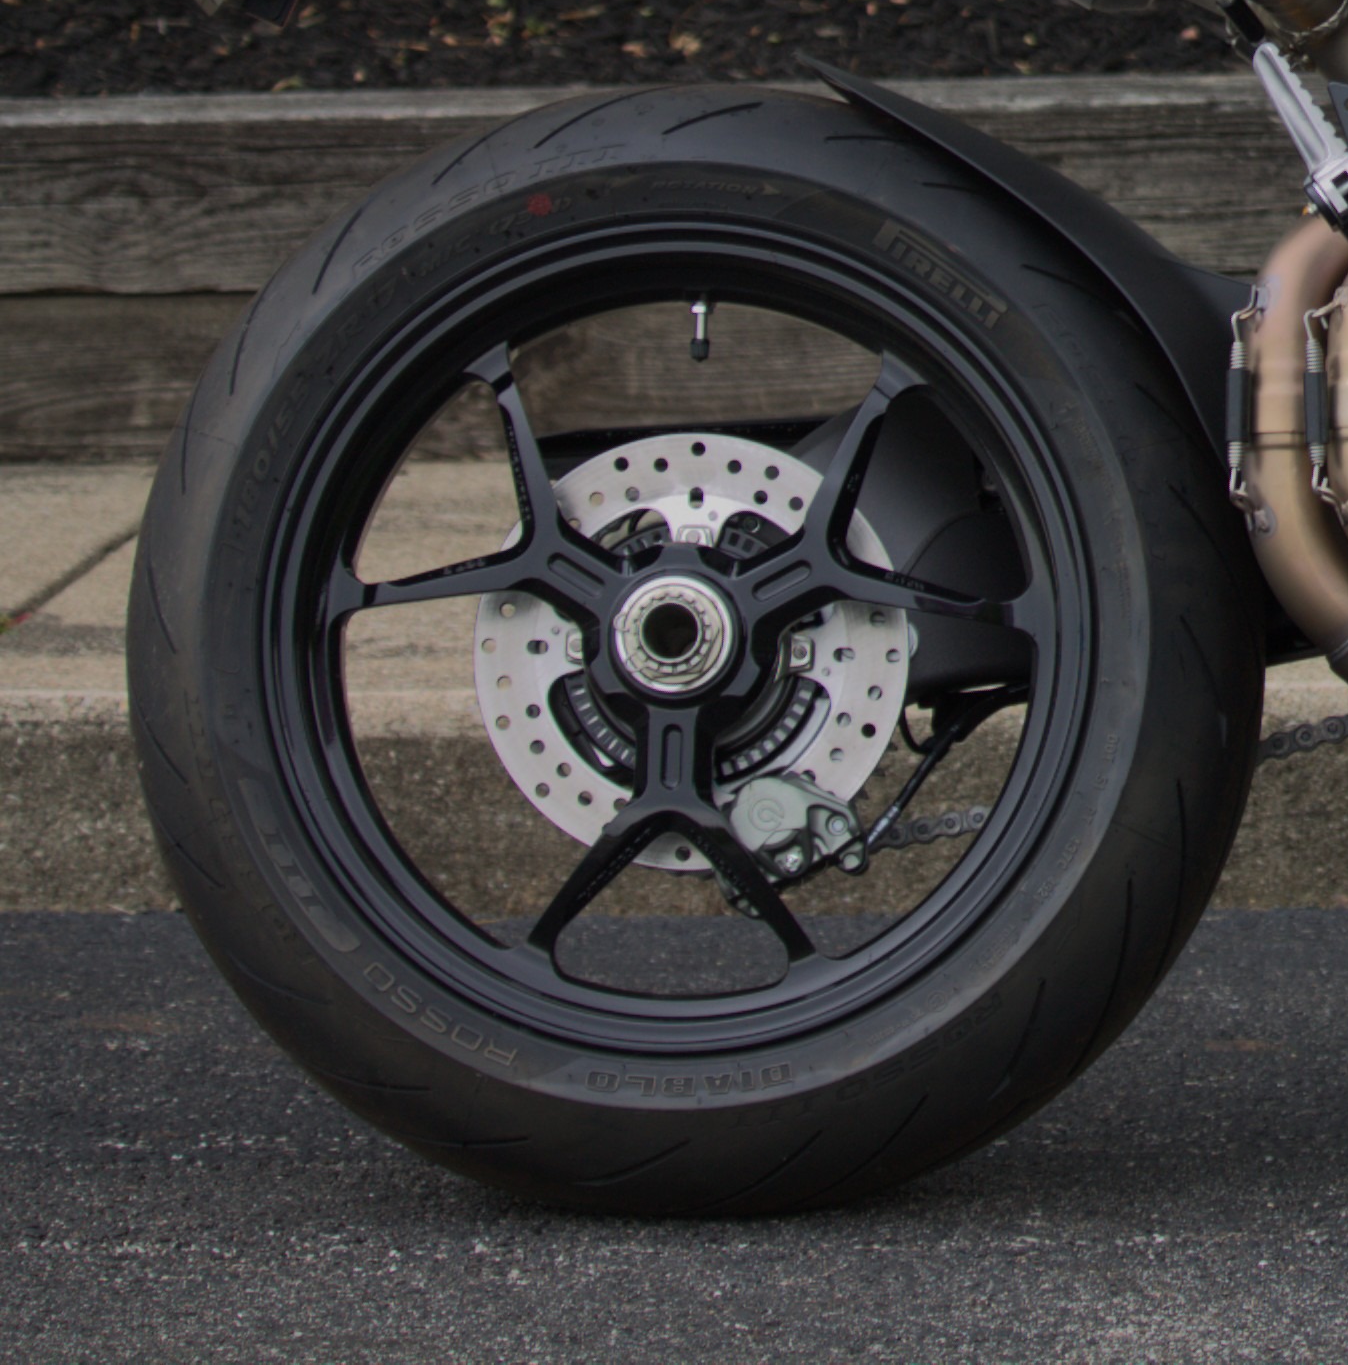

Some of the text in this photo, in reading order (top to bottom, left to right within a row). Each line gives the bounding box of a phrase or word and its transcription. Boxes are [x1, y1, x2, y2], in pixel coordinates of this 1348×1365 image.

[872, 218, 1008, 329] PIRELLI
[362, 960, 519, 1068] ROSSO
[584, 1061, 794, 1098] DIABLO
